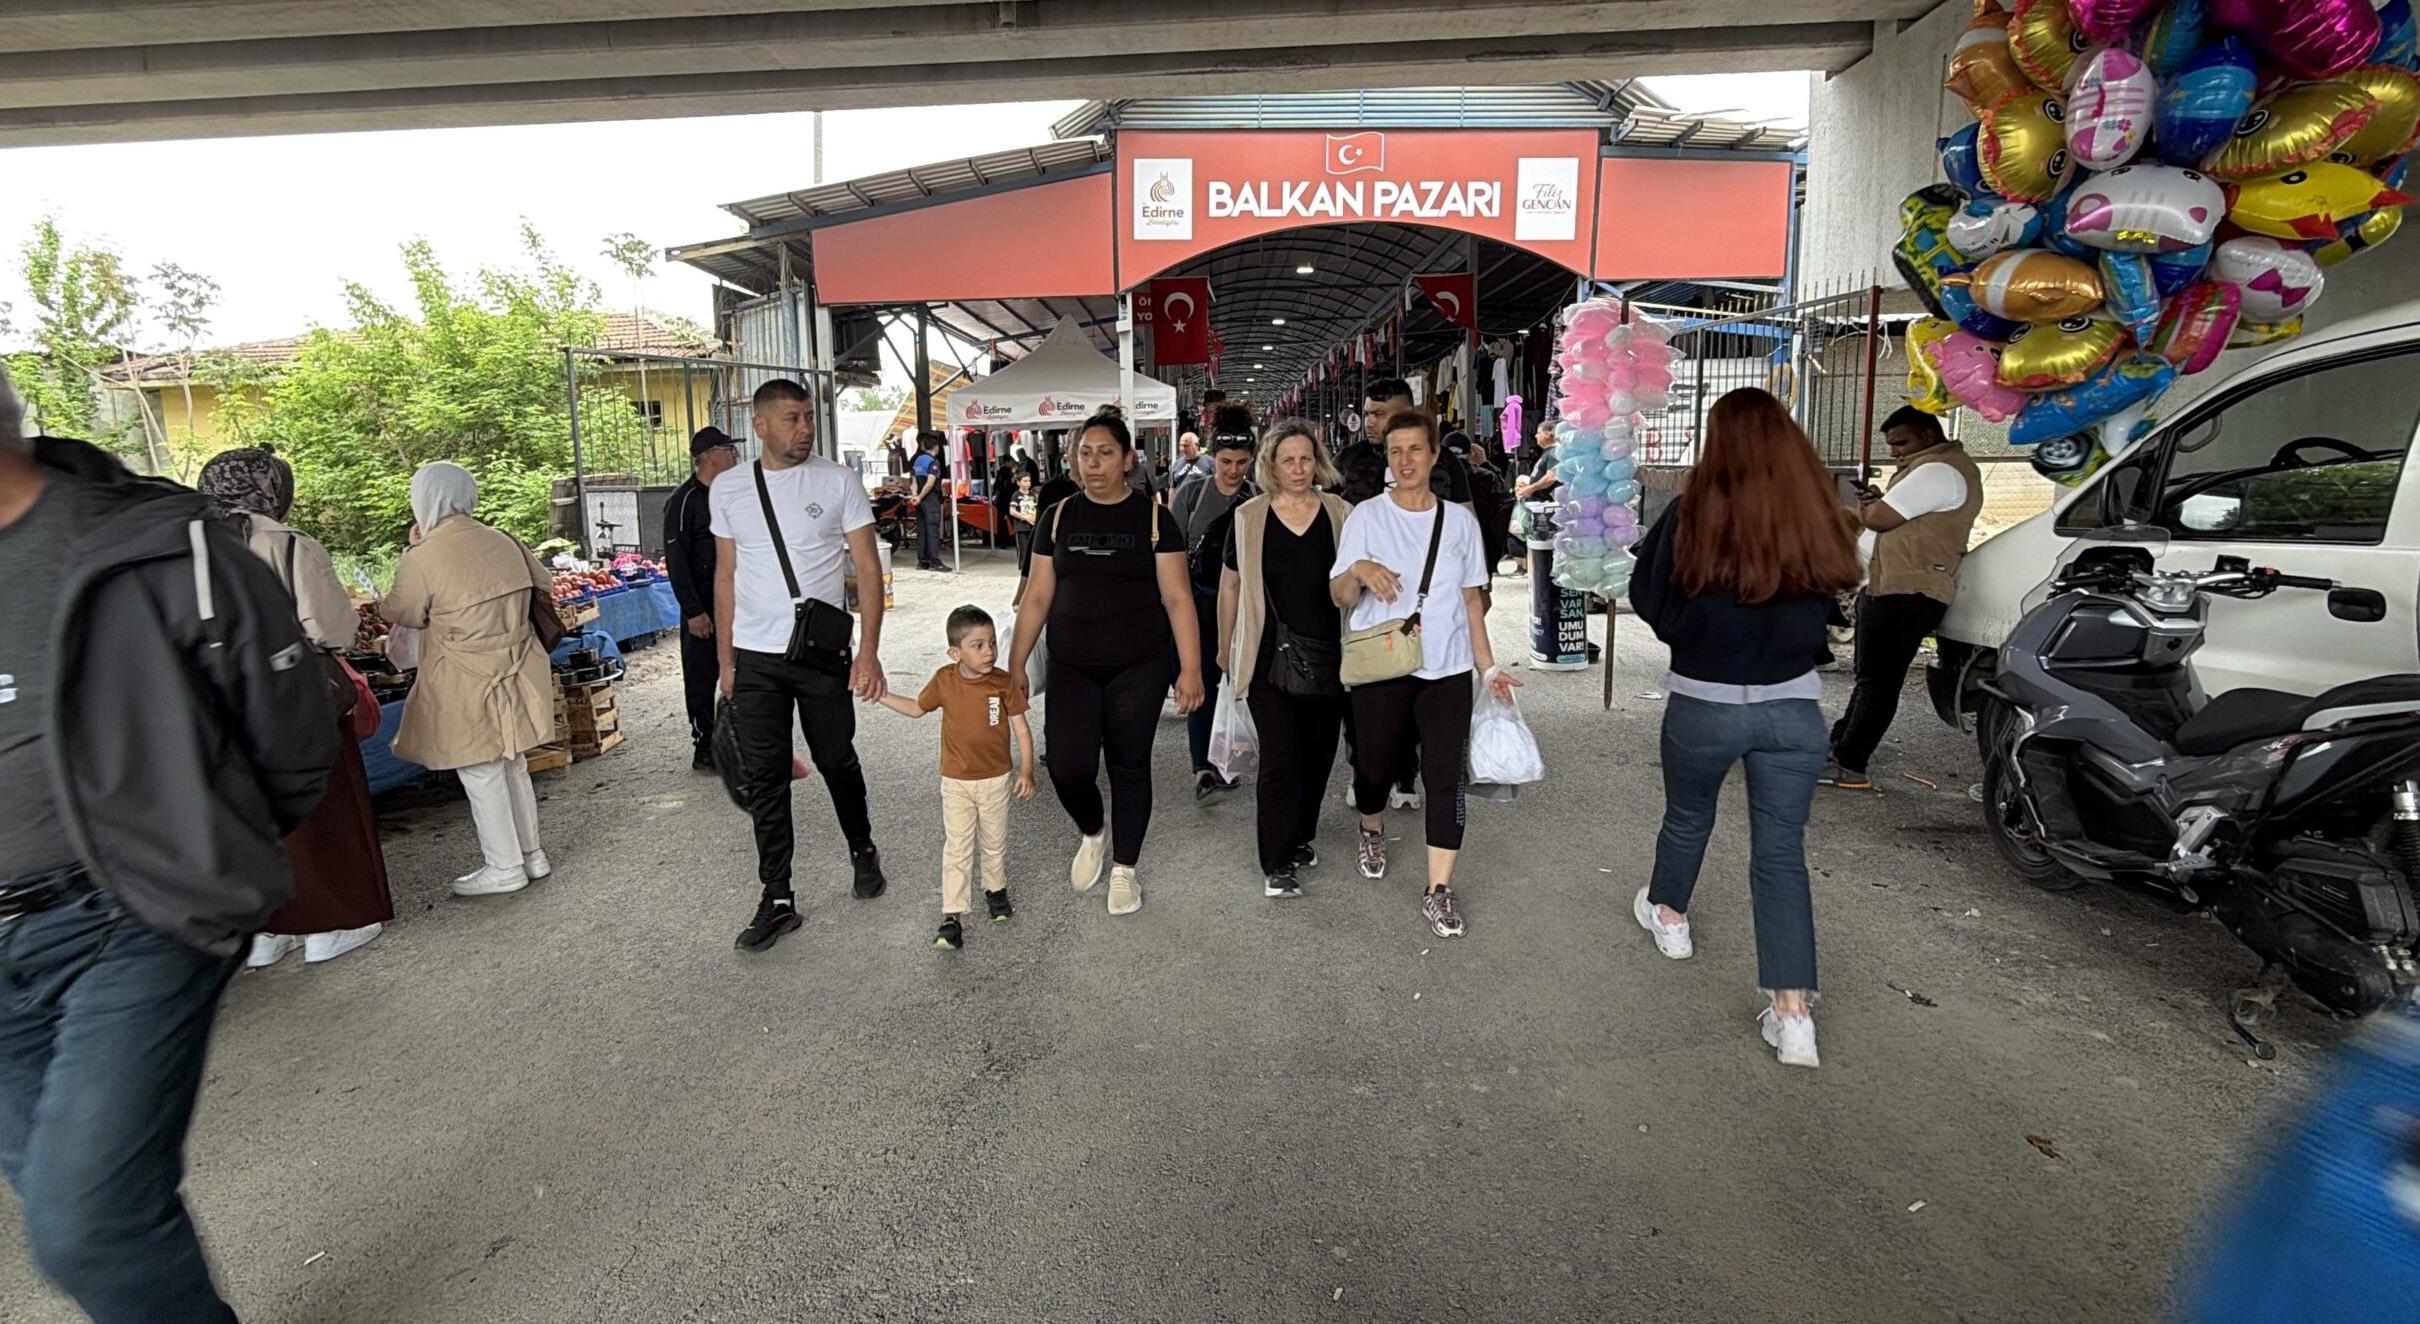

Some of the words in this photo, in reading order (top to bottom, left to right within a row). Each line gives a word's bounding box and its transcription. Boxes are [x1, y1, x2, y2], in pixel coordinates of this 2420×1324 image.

[1533, 183, 1563, 201] Filiz
[1208, 181, 1364, 217] BALKAN
[1373, 181, 1501, 217] PAZARI
[1522, 199, 1571, 210] GENCAN
[1142, 206, 1185, 218] Edirne
[984, 406, 1012, 415] Edirne
[1057, 402, 1085, 411] Edirne
[1560, 599, 1582, 609] VAR
[1558, 620, 1584, 631] UMU
[1558, 631, 1584, 642] DUM
[1559, 641, 1585, 652] VAR!
